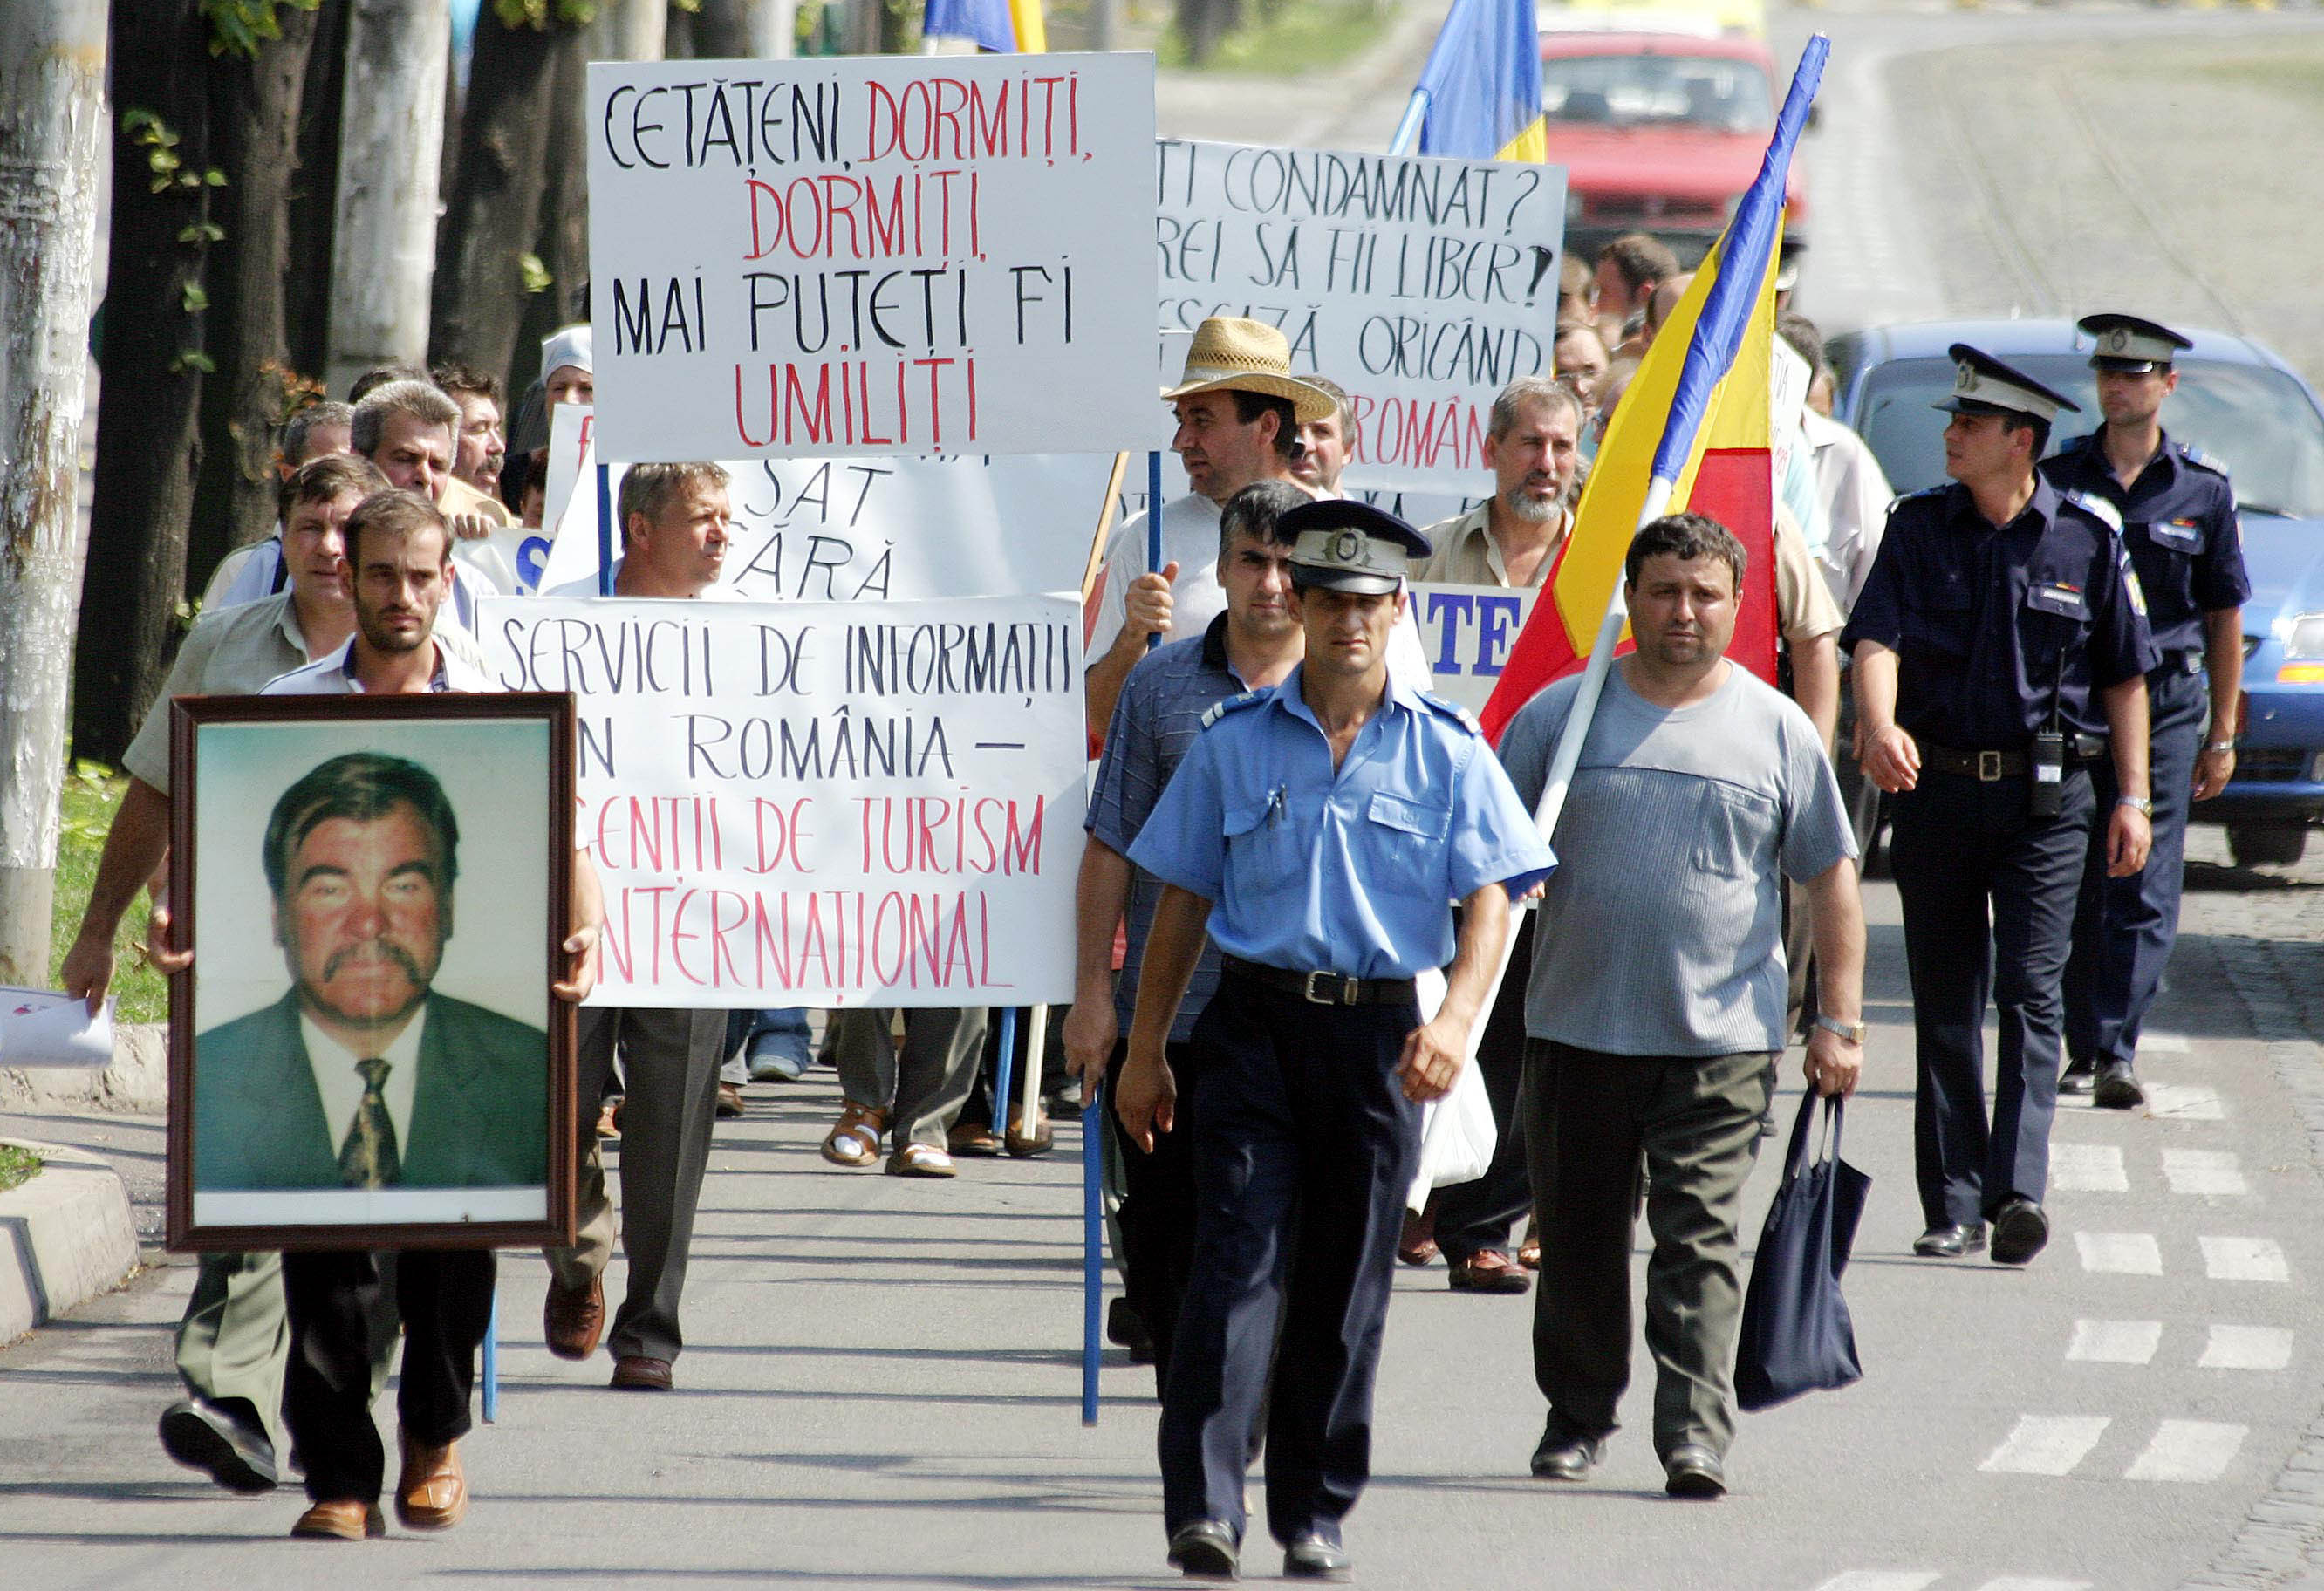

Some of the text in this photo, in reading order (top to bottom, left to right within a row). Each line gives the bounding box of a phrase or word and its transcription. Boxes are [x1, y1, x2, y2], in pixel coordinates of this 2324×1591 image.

[858, 71, 1093, 167] DORMIȚI,
[1249, 218, 1304, 290] SĂ
[1327, 227, 1378, 294] FII
[613, 266, 705, 356] MAI
[742, 260, 967, 358] PUTEȚI
[1009, 256, 1072, 345] FI
[1359, 311, 1541, 387] ORICÂND
[735, 345, 976, 454] UMILIȚI
[500, 612, 1072, 708] SERVICII DE INFORMAȚII
[1409, 591, 1521, 676] TE
[670, 704, 955, 780] ROMÂNIA
[577, 787, 1044, 884] ENȚII DE TURISM
